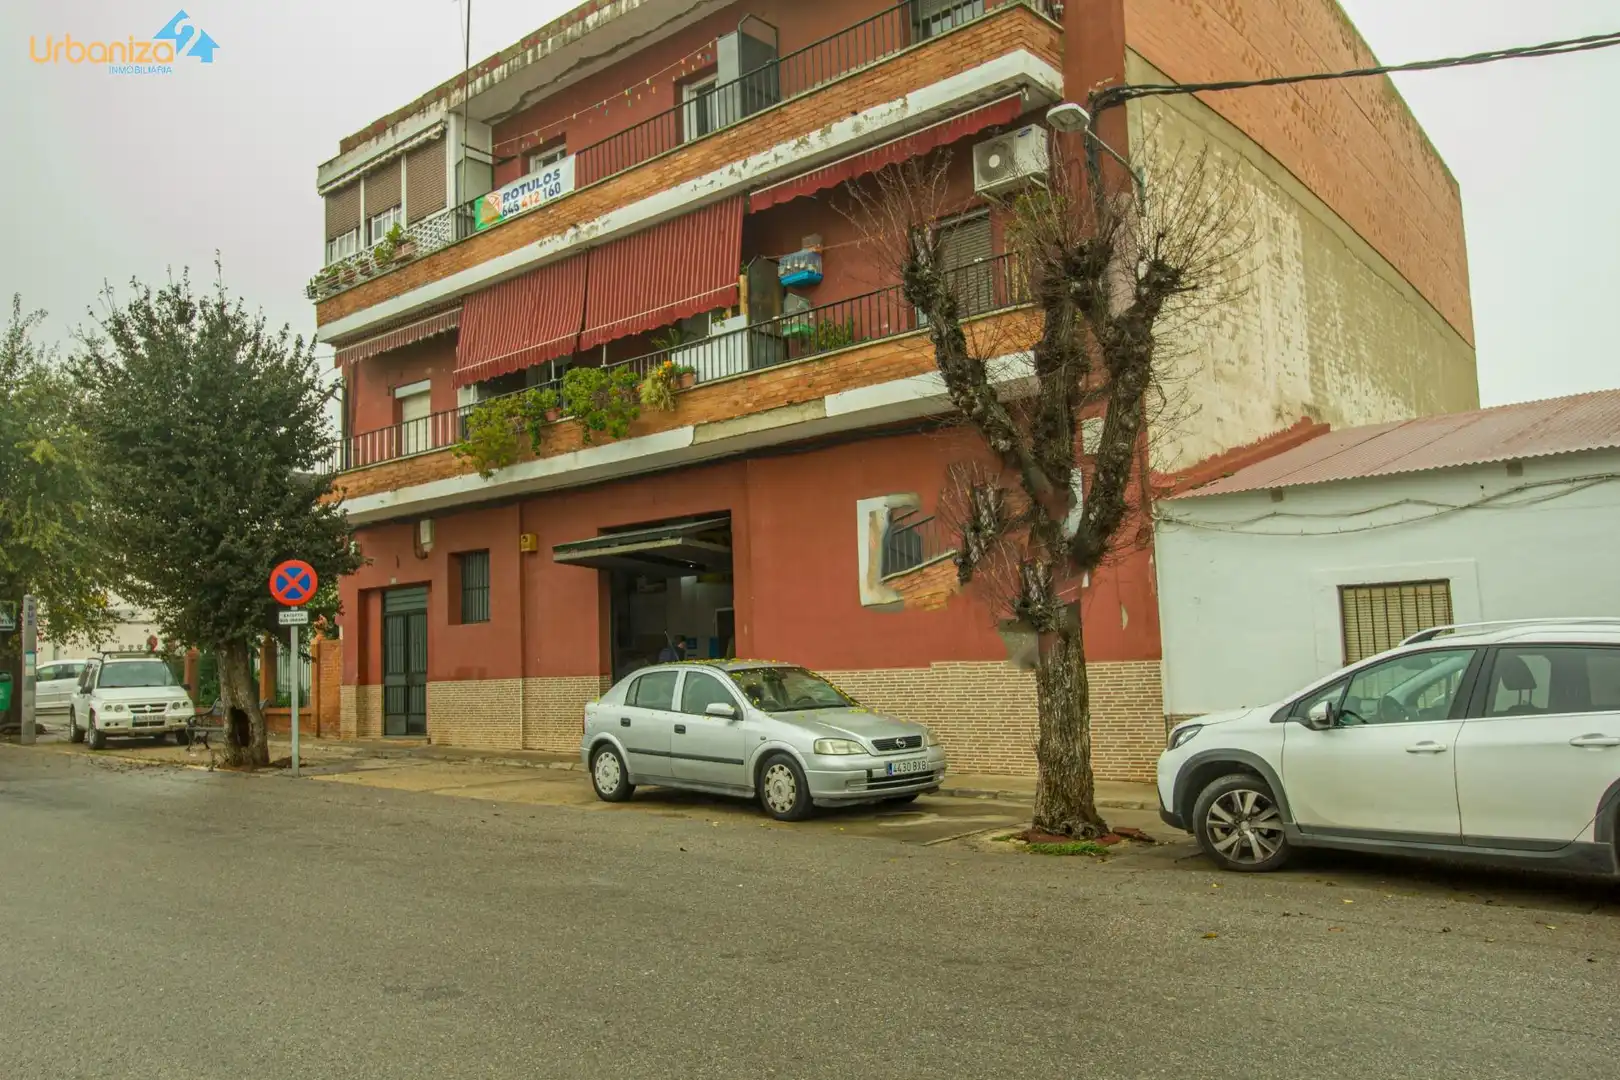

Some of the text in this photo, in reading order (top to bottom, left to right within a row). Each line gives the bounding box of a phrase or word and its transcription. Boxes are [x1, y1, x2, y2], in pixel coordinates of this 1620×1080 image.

[502, 200, 520, 217] 645
[542, 182, 561, 200] 160
[503, 168, 561, 204] ROTULOS
[893, 762, 912, 773] 4430
